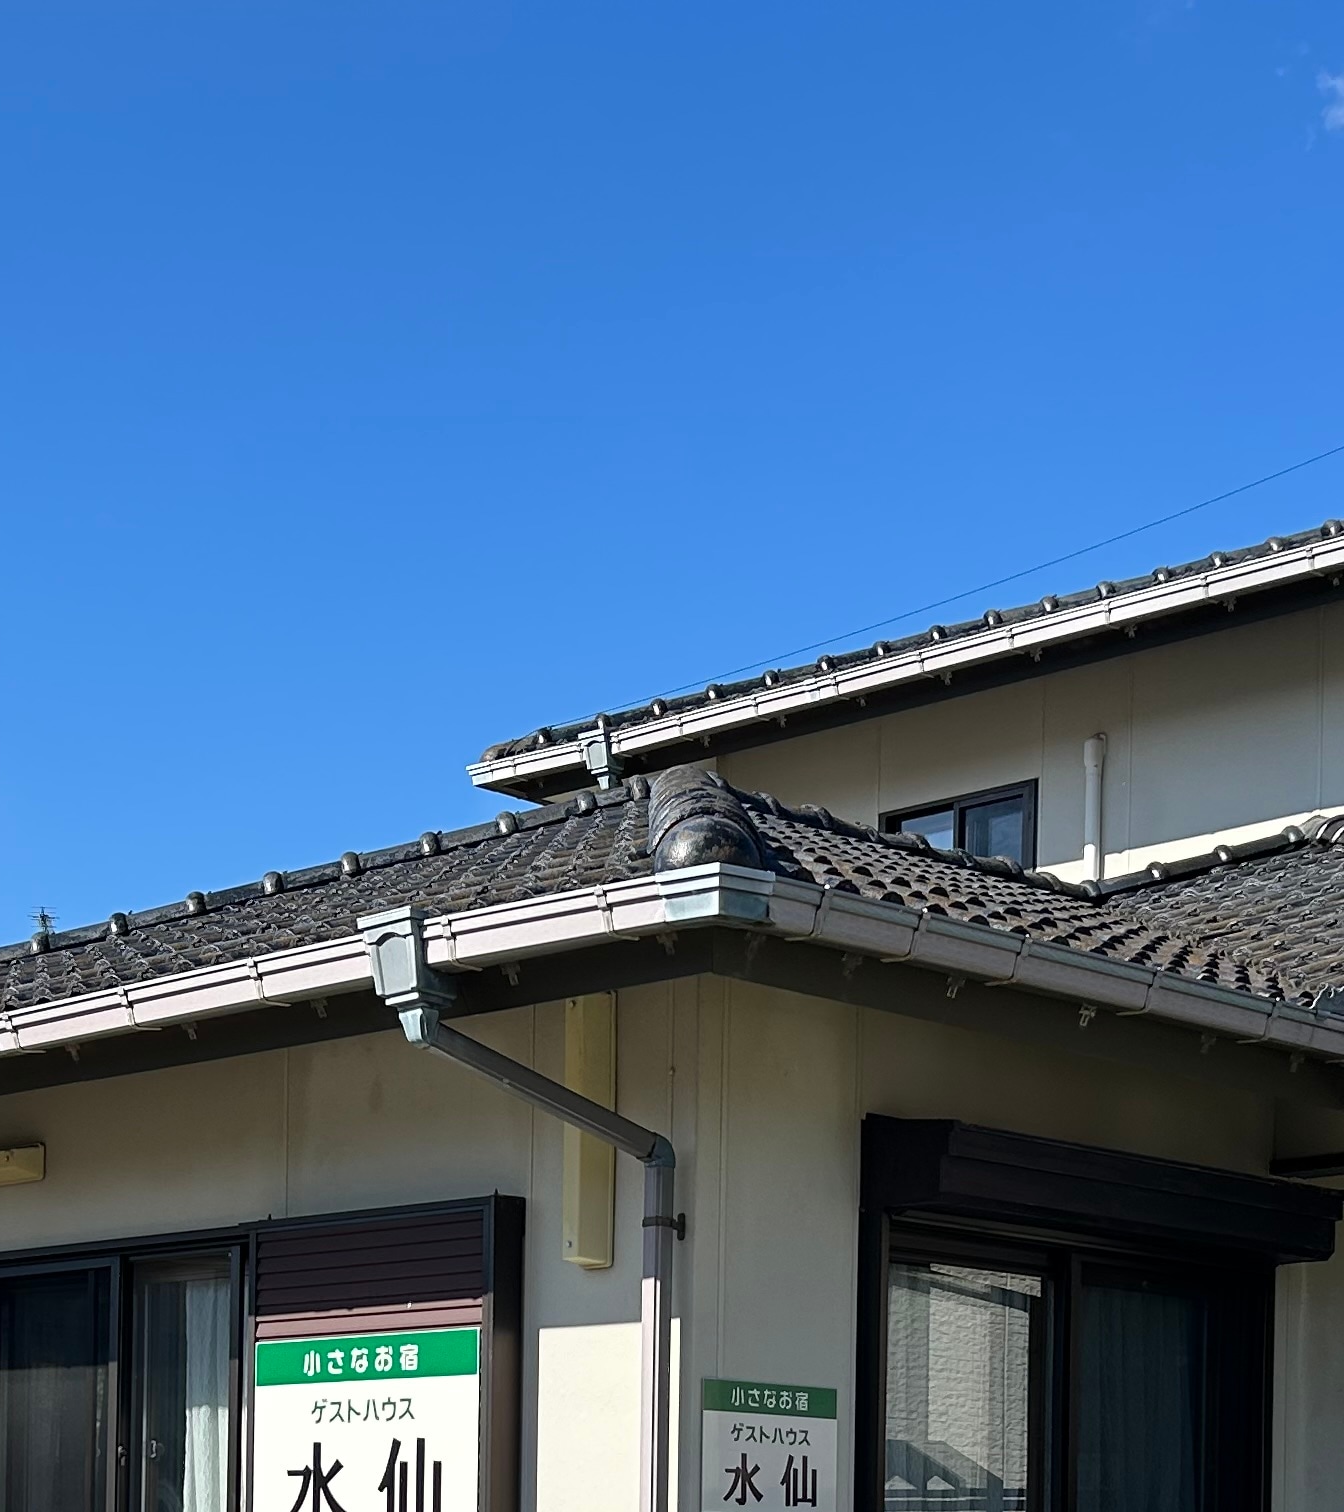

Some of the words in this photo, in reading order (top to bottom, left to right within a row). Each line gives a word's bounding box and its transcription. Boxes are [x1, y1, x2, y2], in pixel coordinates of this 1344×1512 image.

[303, 1344, 419, 1377] 小さなお宿
[311, 1397, 415, 1424] ゲストハウス
[731, 1386, 809, 1411] 小さなお宿
[730, 1423, 810, 1446] ゲストハウス
[723, 1453, 817, 1507] 水仙
